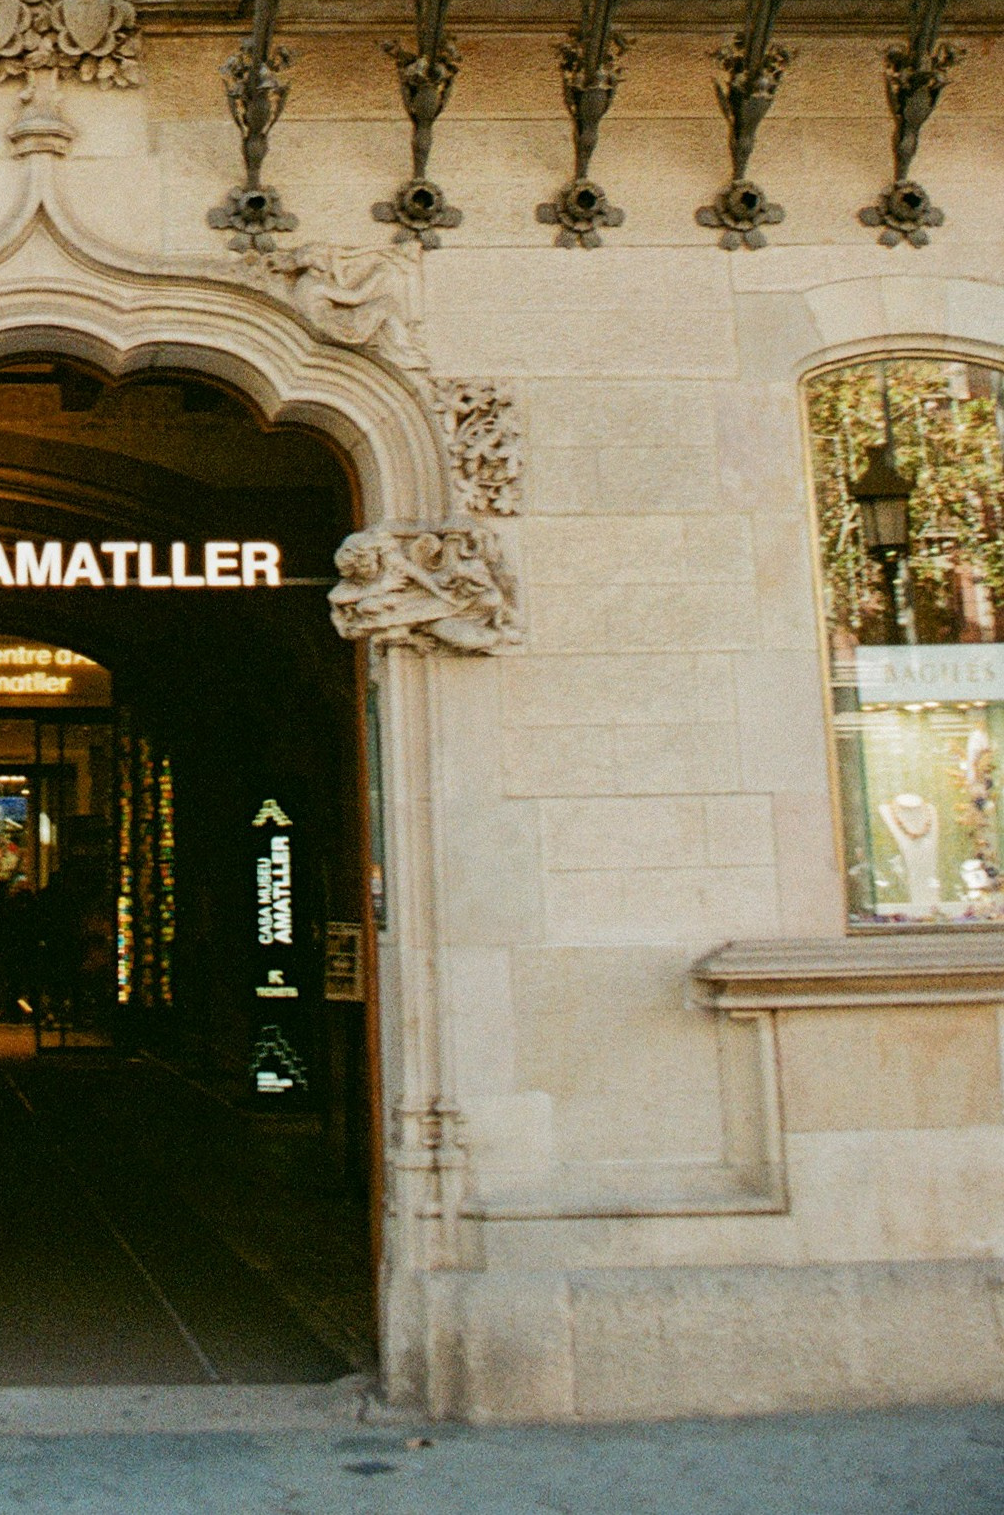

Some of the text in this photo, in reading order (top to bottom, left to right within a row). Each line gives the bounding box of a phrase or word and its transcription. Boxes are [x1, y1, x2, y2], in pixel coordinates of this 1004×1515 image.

[256, 857, 274, 945] CASA MUSEU
[270, 836, 293, 945] AMATLLER
